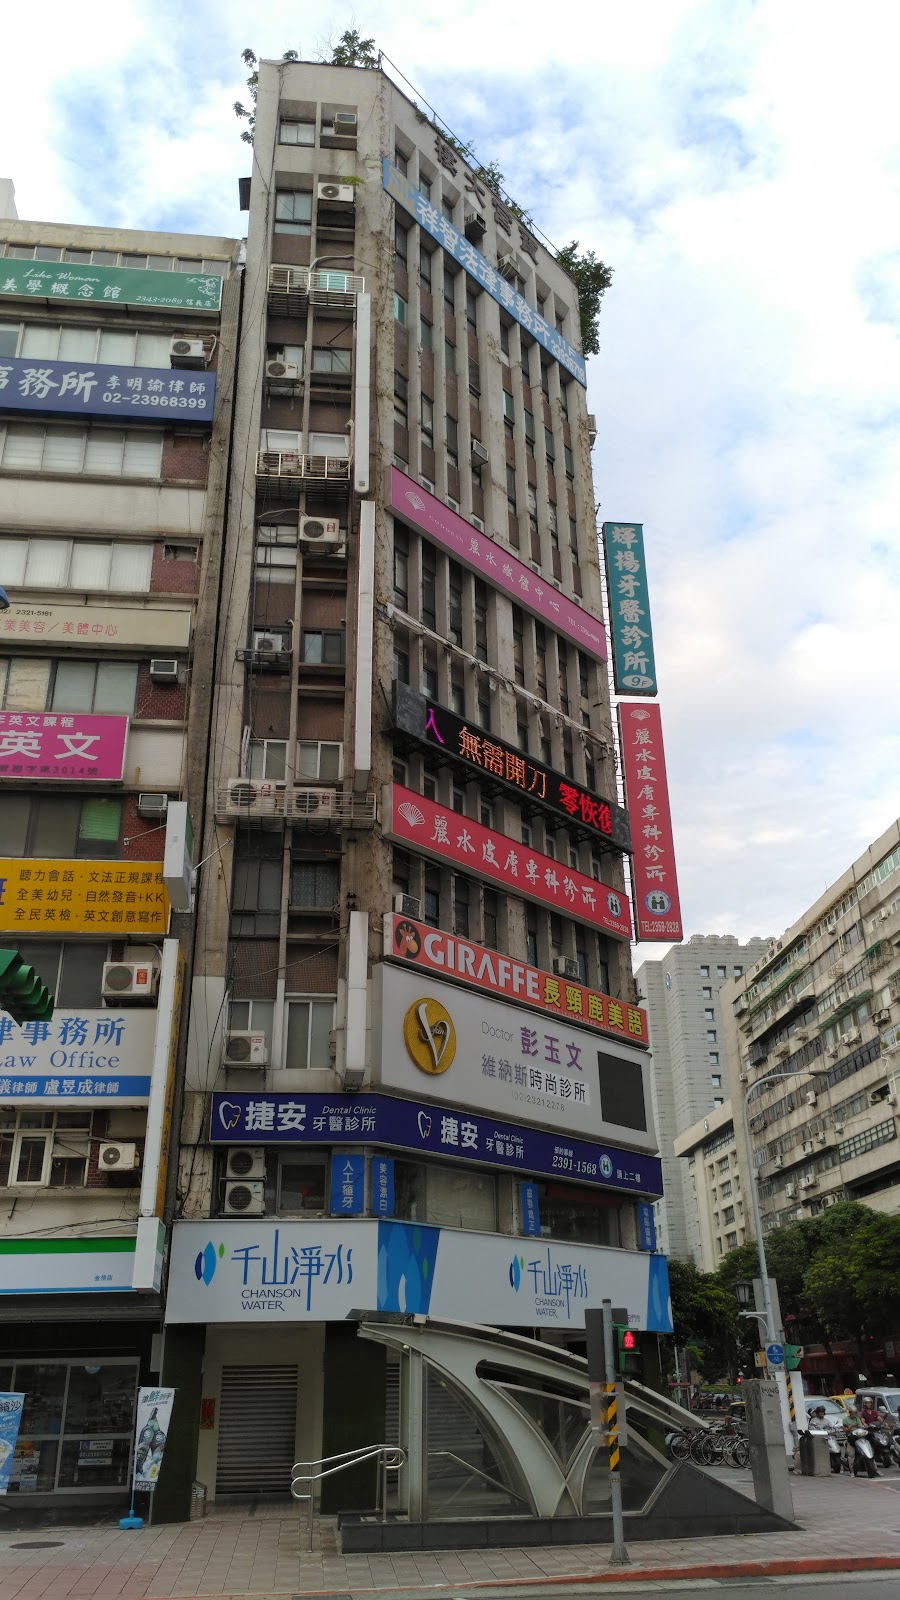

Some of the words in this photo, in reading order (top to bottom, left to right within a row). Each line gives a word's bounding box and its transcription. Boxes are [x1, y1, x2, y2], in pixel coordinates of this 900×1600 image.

[57, 272, 101, 283] Woman
[417, 196, 550, 347] 祥智法律事務所
[106, 375, 206, 396] 李明諭律師
[103, 393, 207, 409] 02-23968399
[16, 609, 53, 617] 2321-5161
[0, 618, 118, 637] 業美容/美體中心
[631, 676, 648, 688] 9F
[459, 726, 547, 799] 無需開刀
[632, 728, 667, 883] 麗水皮膚專科診所
[431, 815, 597, 912] 麗水皮膚專科診所
[424, 933, 540, 1000] GIRAFFE
[544, 977, 643, 1036] 長頸鹿美語
[482, 1021, 514, 1042] Doctor
[0, 1055, 37, 1067] aw
[50, 1050, 120, 1068] Office
[520, 1026, 583, 1072] 彭玉文
[482, 1053, 586, 1104] 維納斯時尚診所
[245, 1101, 306, 1131] 捷安
[322, 1106, 351, 1114] Dental
[353, 1106, 377, 1114] Clinic
[312, 1117, 377, 1132] 牙醫診所
[441, 1116, 478, 1150] 捷安
[494, 1131, 510, 1141] Dental
[510, 1134, 524, 1144] Clinic
[486, 1138, 524, 1159] 牙醫診所
[552, 1156, 597, 1175] 2391-1568
[342, 1160, 355, 1209] 人工植牙
[231, 1229, 354, 1312] 千山淨水
[241, 1288, 301, 1299] CHANSON
[527, 1247, 588, 1320] 千山淨水
[241, 1300, 285, 1312] WATER
[534, 1299, 565, 1308] CHANSON
[535, 1308, 558, 1319] WATER
